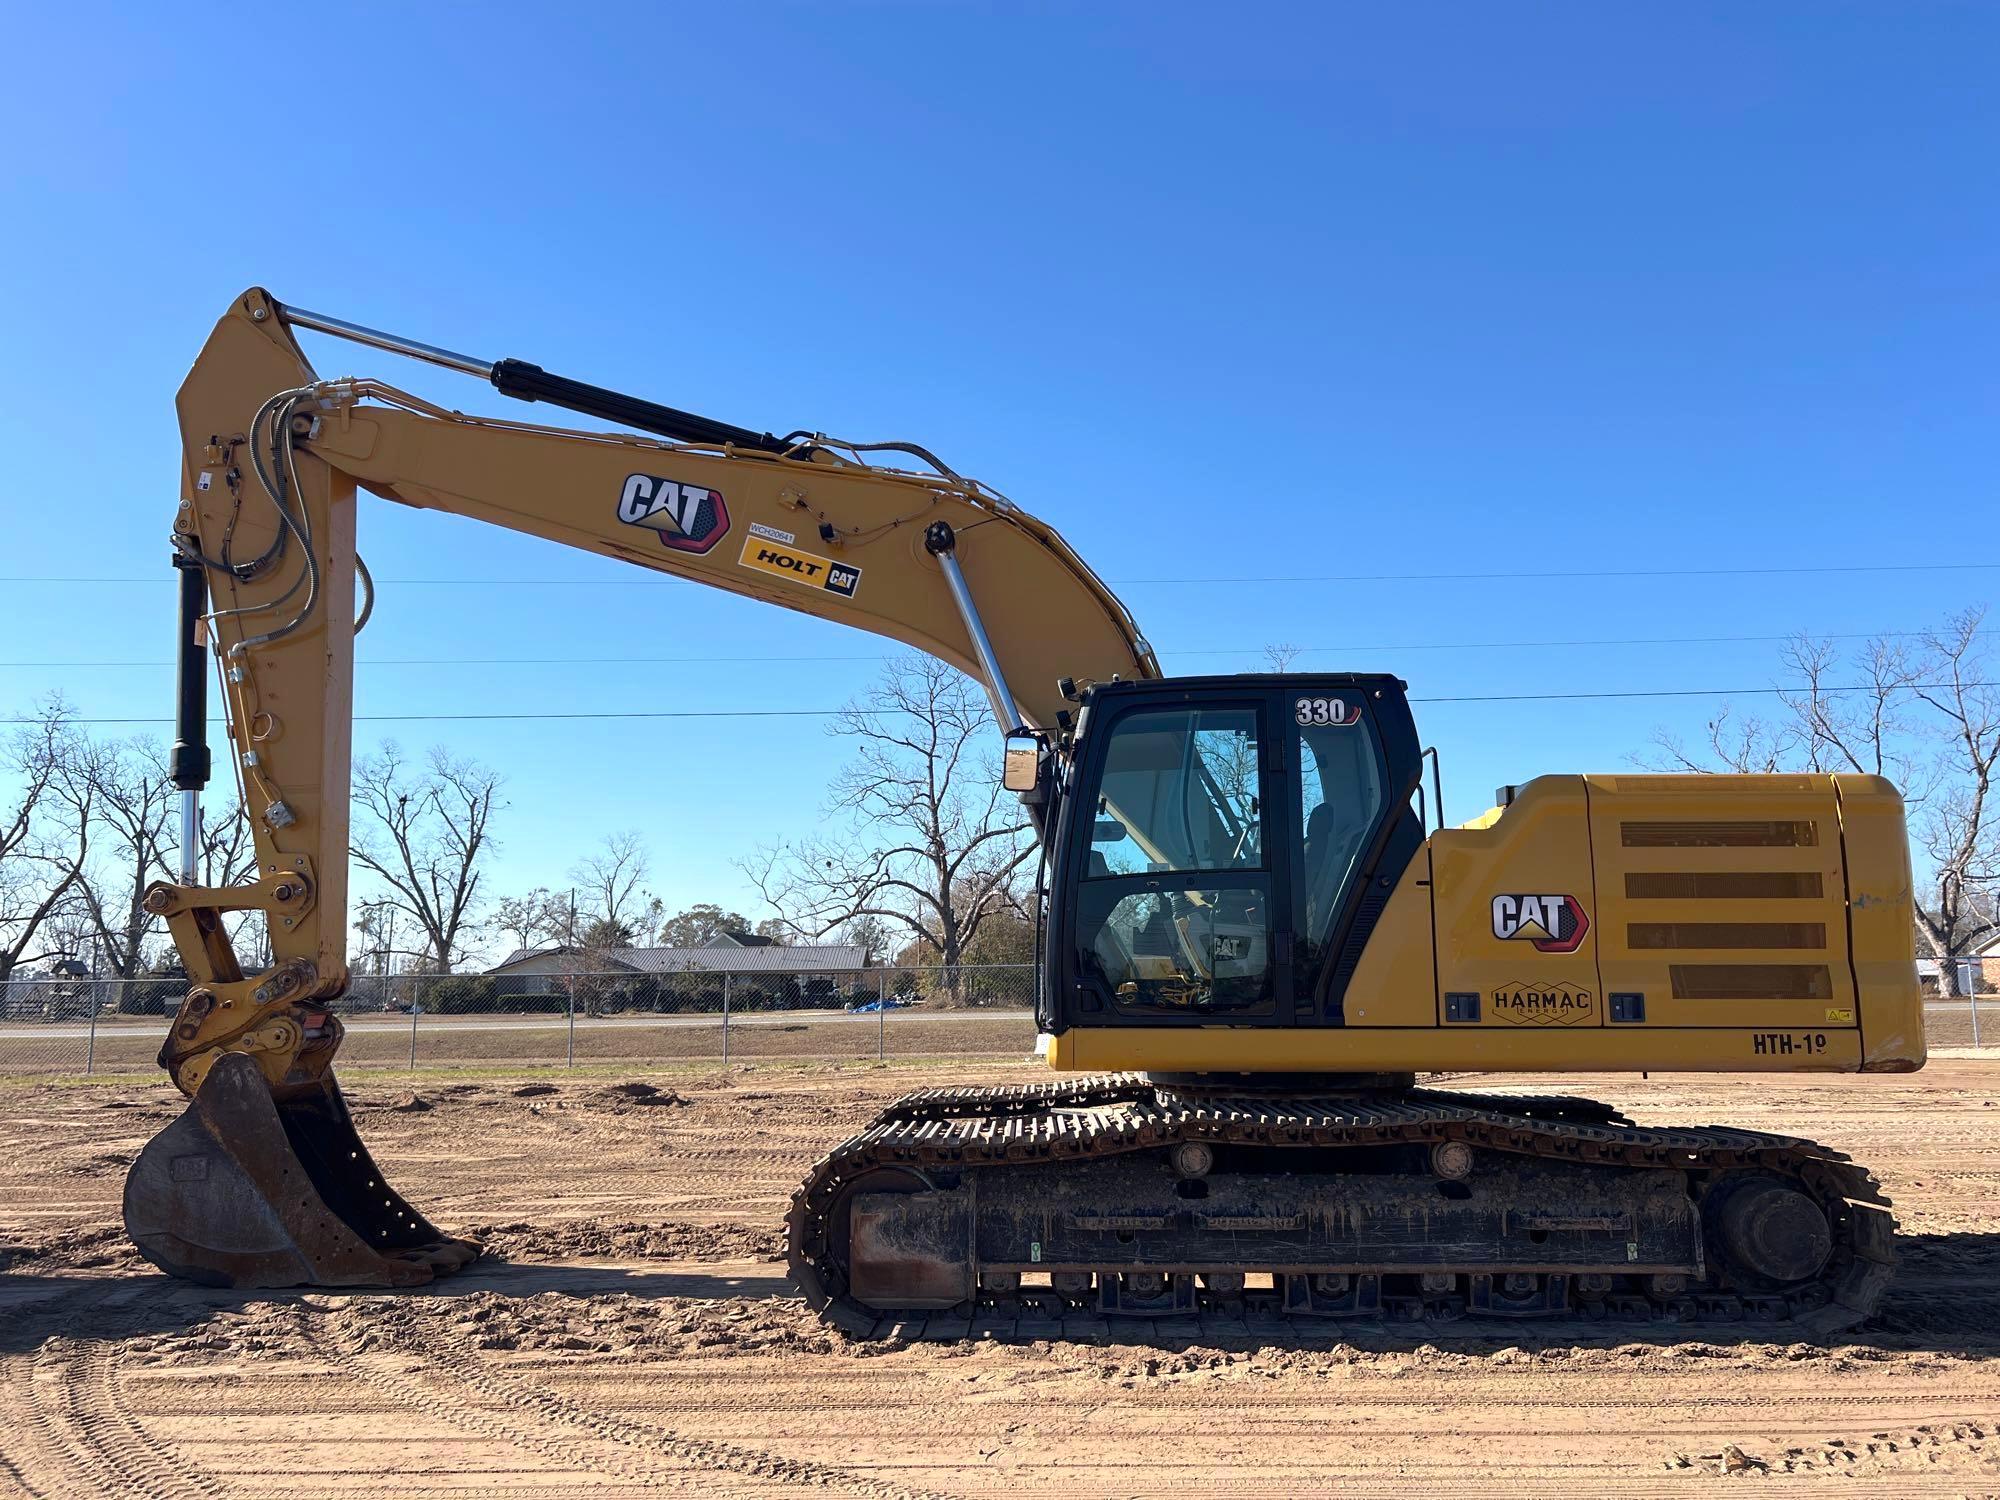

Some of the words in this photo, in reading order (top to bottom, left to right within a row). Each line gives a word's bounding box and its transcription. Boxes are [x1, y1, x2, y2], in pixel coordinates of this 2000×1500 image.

[620, 474, 709, 536] CAT
[751, 524, 793, 542] WCH20641
[757, 549, 822, 576] HOLT
[829, 569, 856, 589] CAT
[1296, 699, 1345, 724] 330
[1492, 895, 1564, 939] CAT
[1495, 992, 1589, 1008] HARMAC
